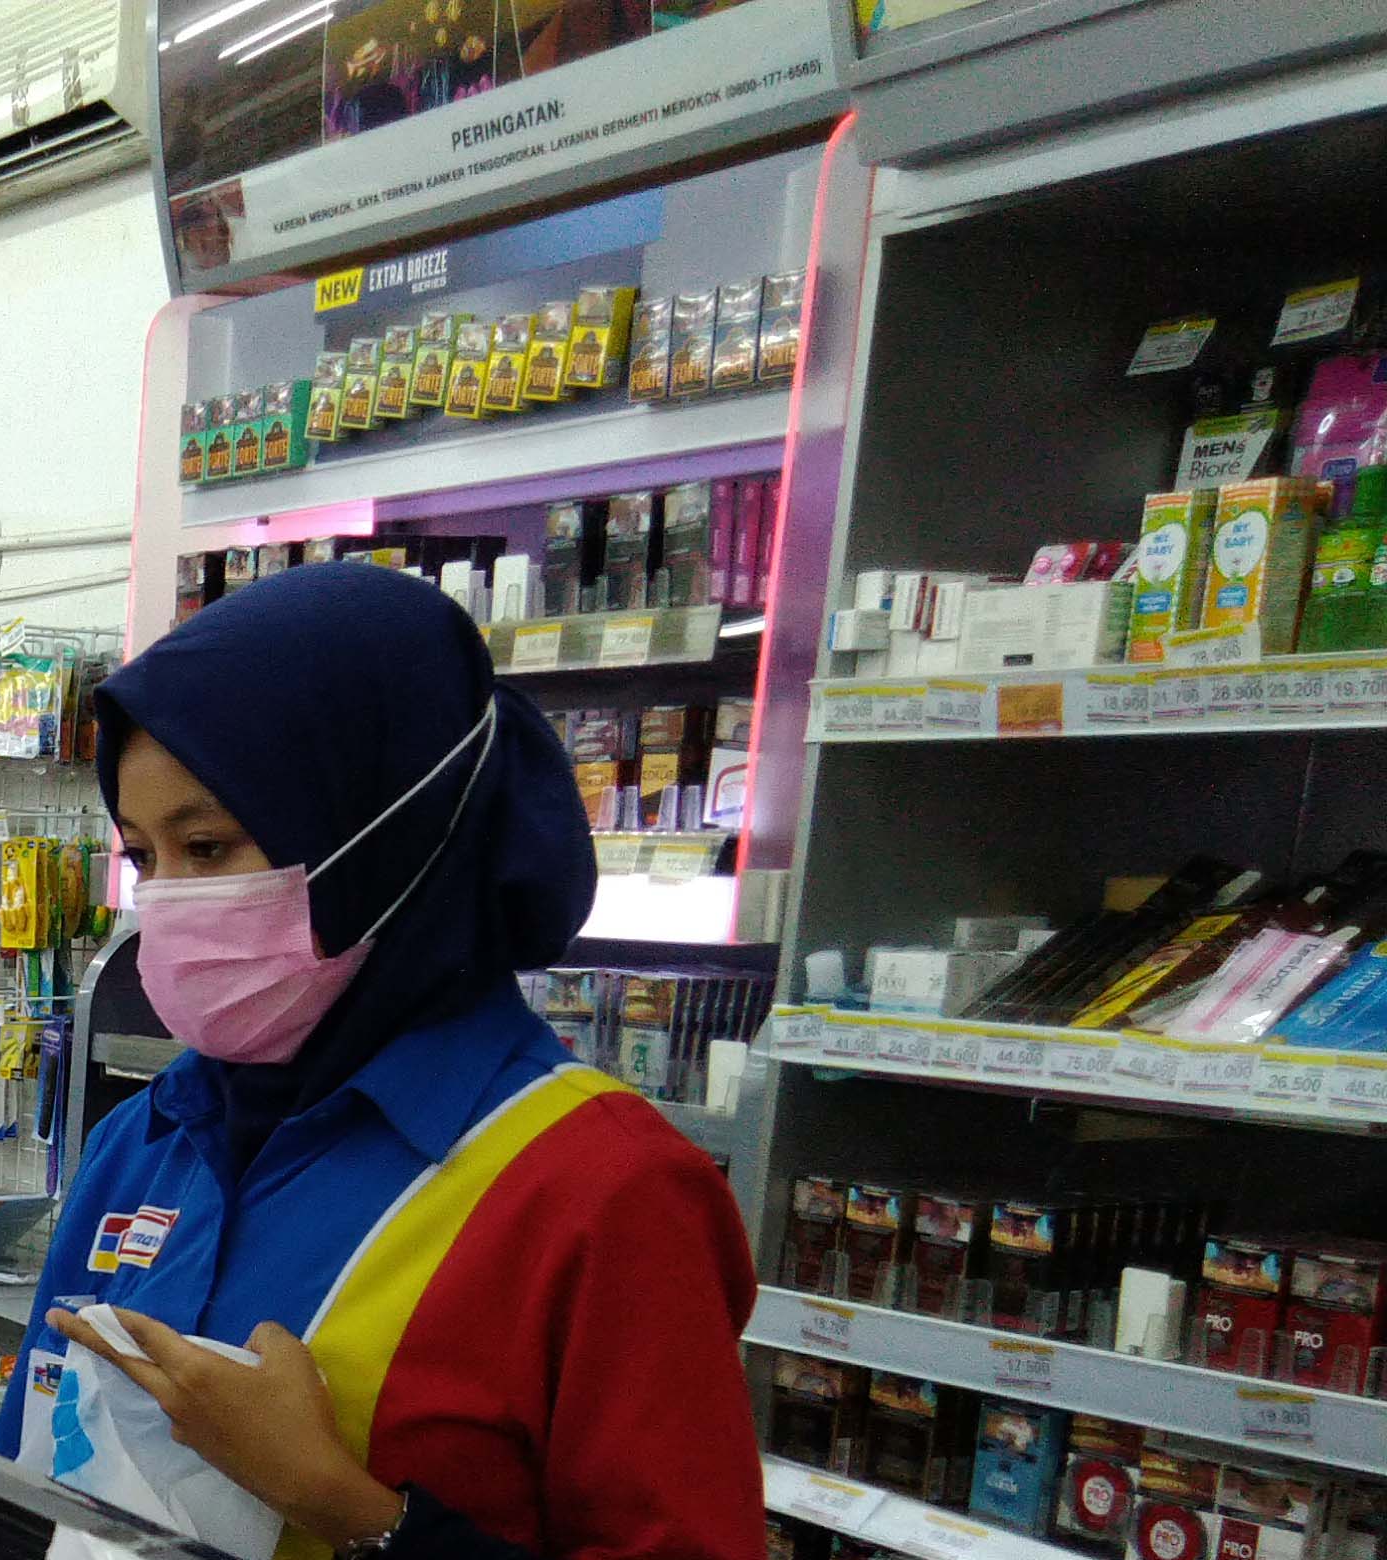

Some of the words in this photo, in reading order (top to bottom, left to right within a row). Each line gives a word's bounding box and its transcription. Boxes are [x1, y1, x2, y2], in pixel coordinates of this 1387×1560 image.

[451, 99, 566, 152] PERINGATAN:
[274, 214, 308, 235] KARENA
[357, 192, 380, 211] SAYA
[426, 166, 466, 189] KANKER
[550, 125, 599, 152] LAYANAN
[602, 110, 659, 137] BERHENTI
[661, 87, 722, 119] MEROKOK
[369, 264, 404, 293] EXTRA
[407, 249, 449, 282] BREEZE
[320, 275, 359, 302] NEW
[411, 276, 447, 294] SERIES
[1189, 454, 1241, 482] Bioré
[1267, 1075, 1323, 1094] 26.500
[1205, 1314, 1233, 1332] PRO
[1293, 1330, 1324, 1349] PRO
[1223, 1540, 1253, 1559] PRO
